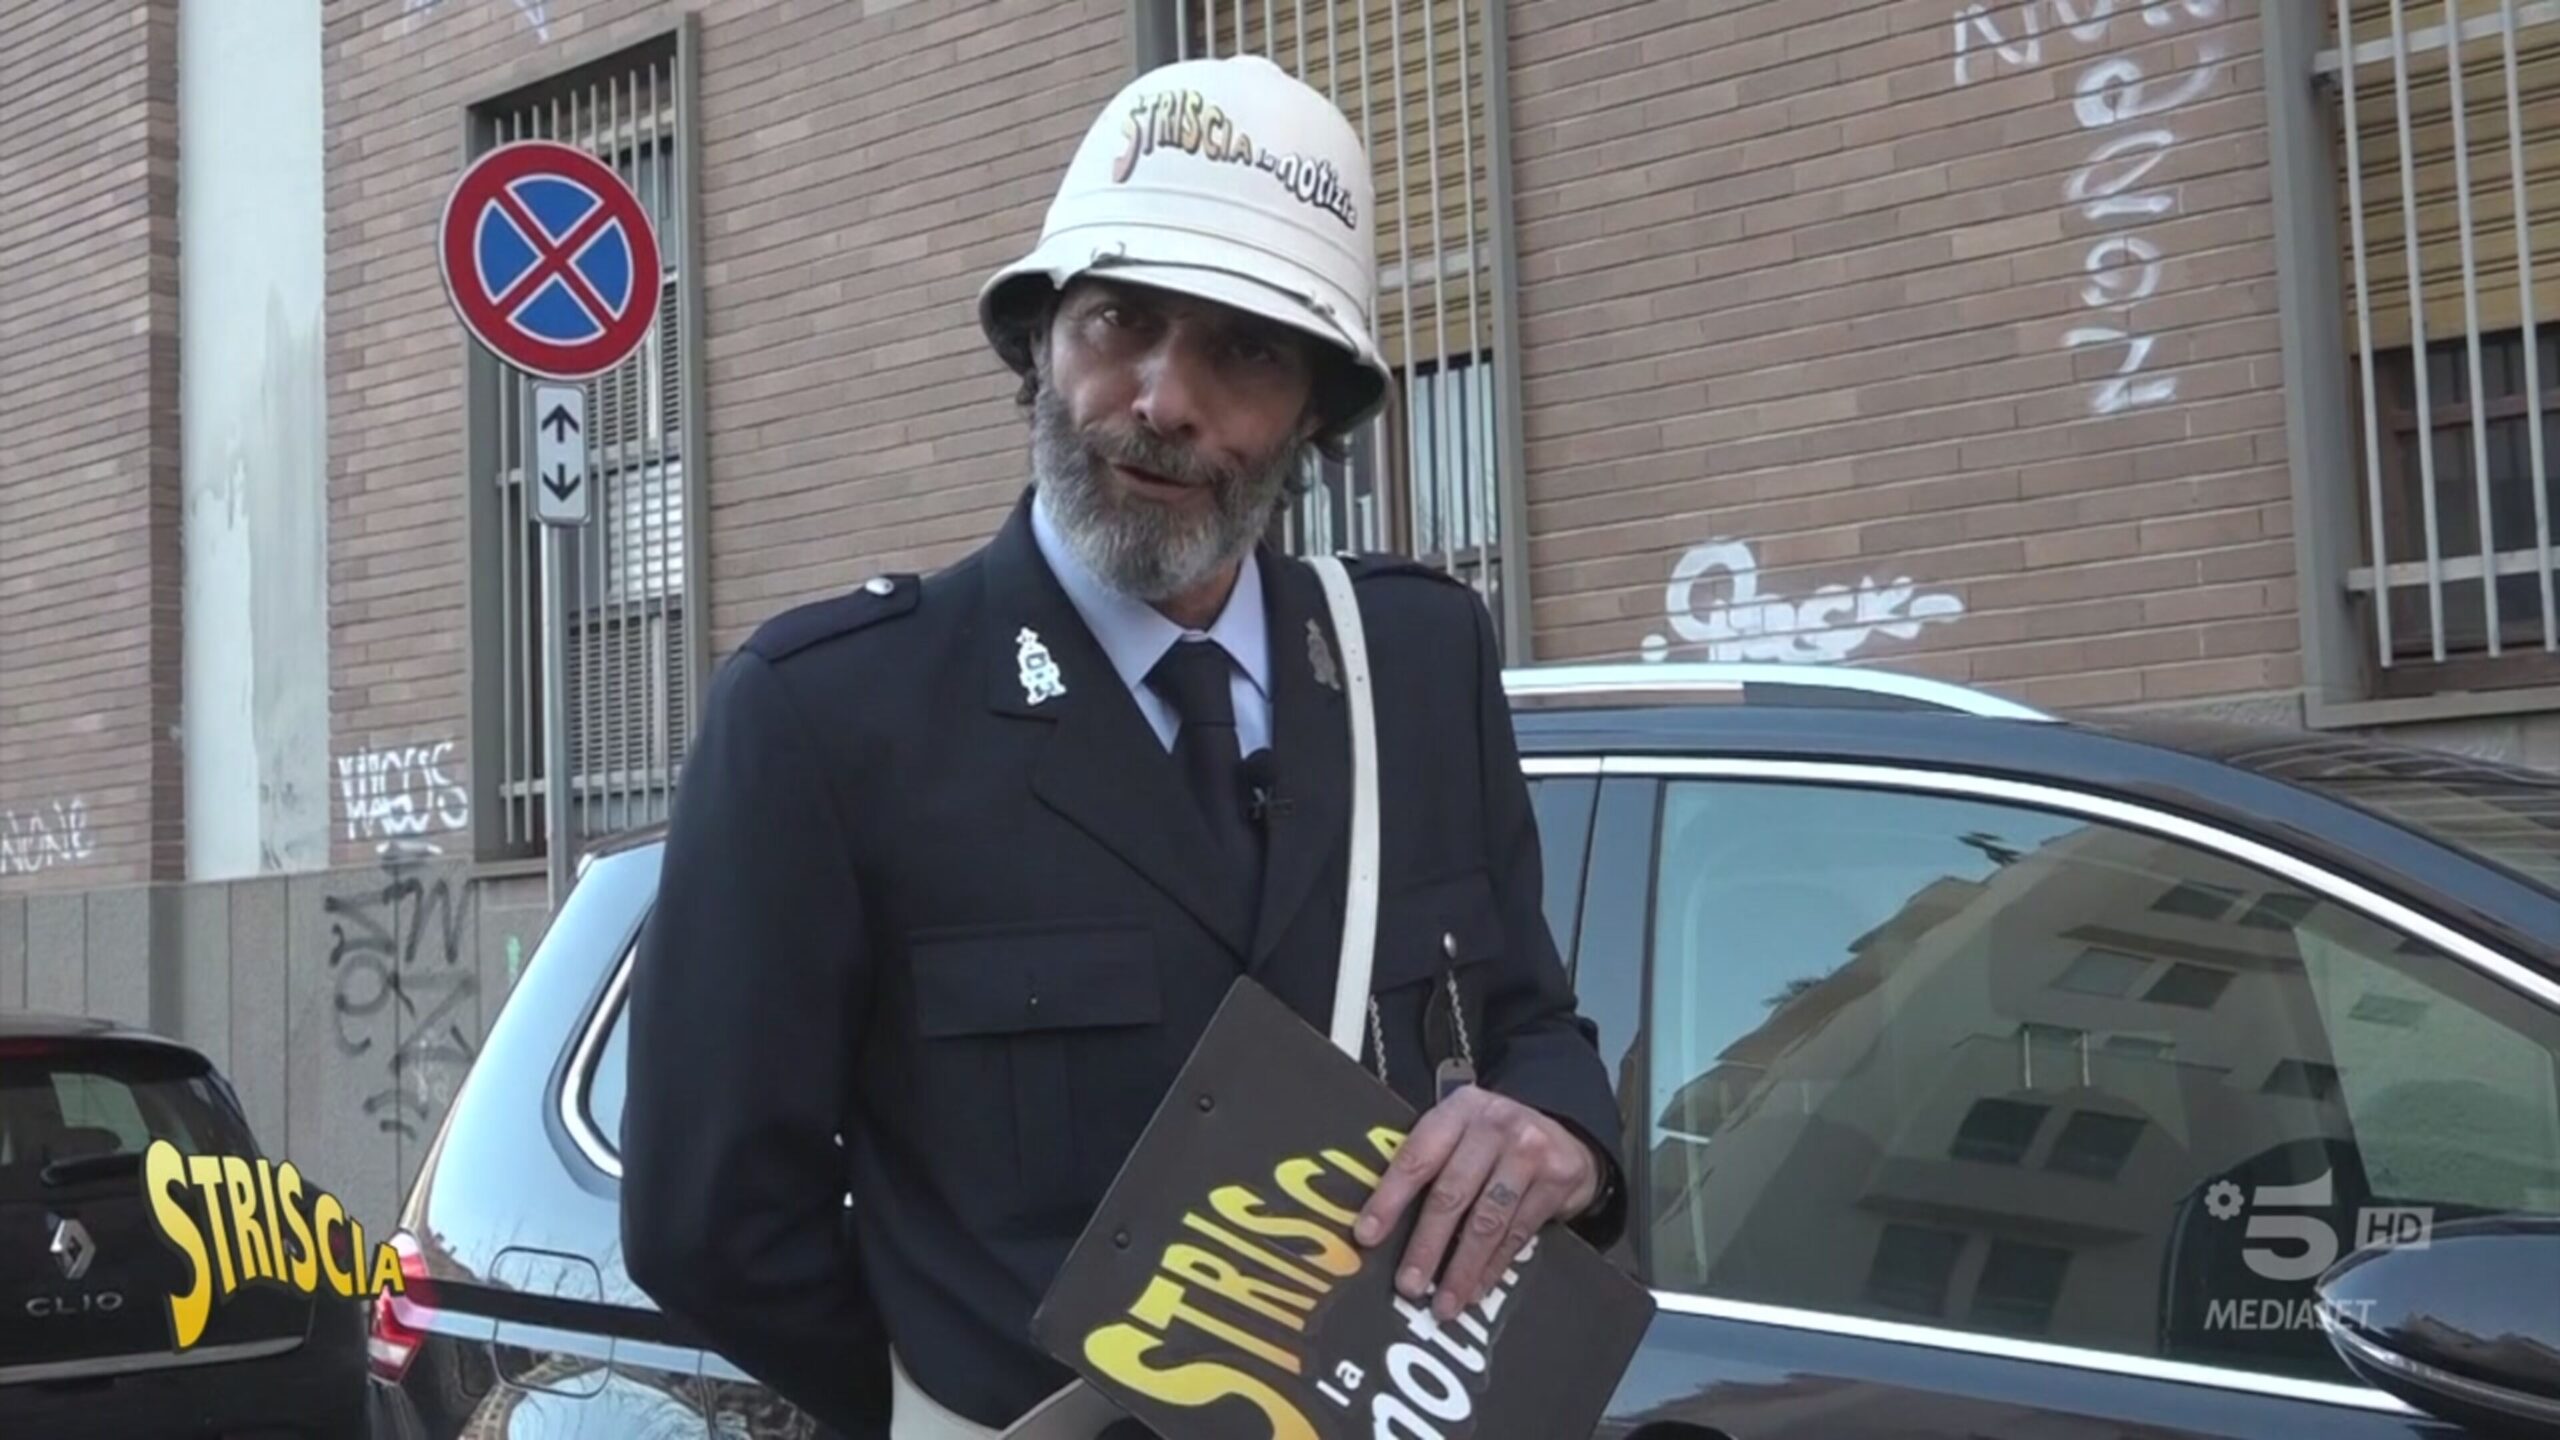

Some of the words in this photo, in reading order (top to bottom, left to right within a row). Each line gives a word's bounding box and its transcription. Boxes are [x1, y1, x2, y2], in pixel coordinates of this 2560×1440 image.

[1112, 88, 1252, 184] STRISCIA
[1276, 153, 1357, 230] notizia
[25, 1290, 123, 1318] CLIO
[1316, 1356, 1366, 1407] la
